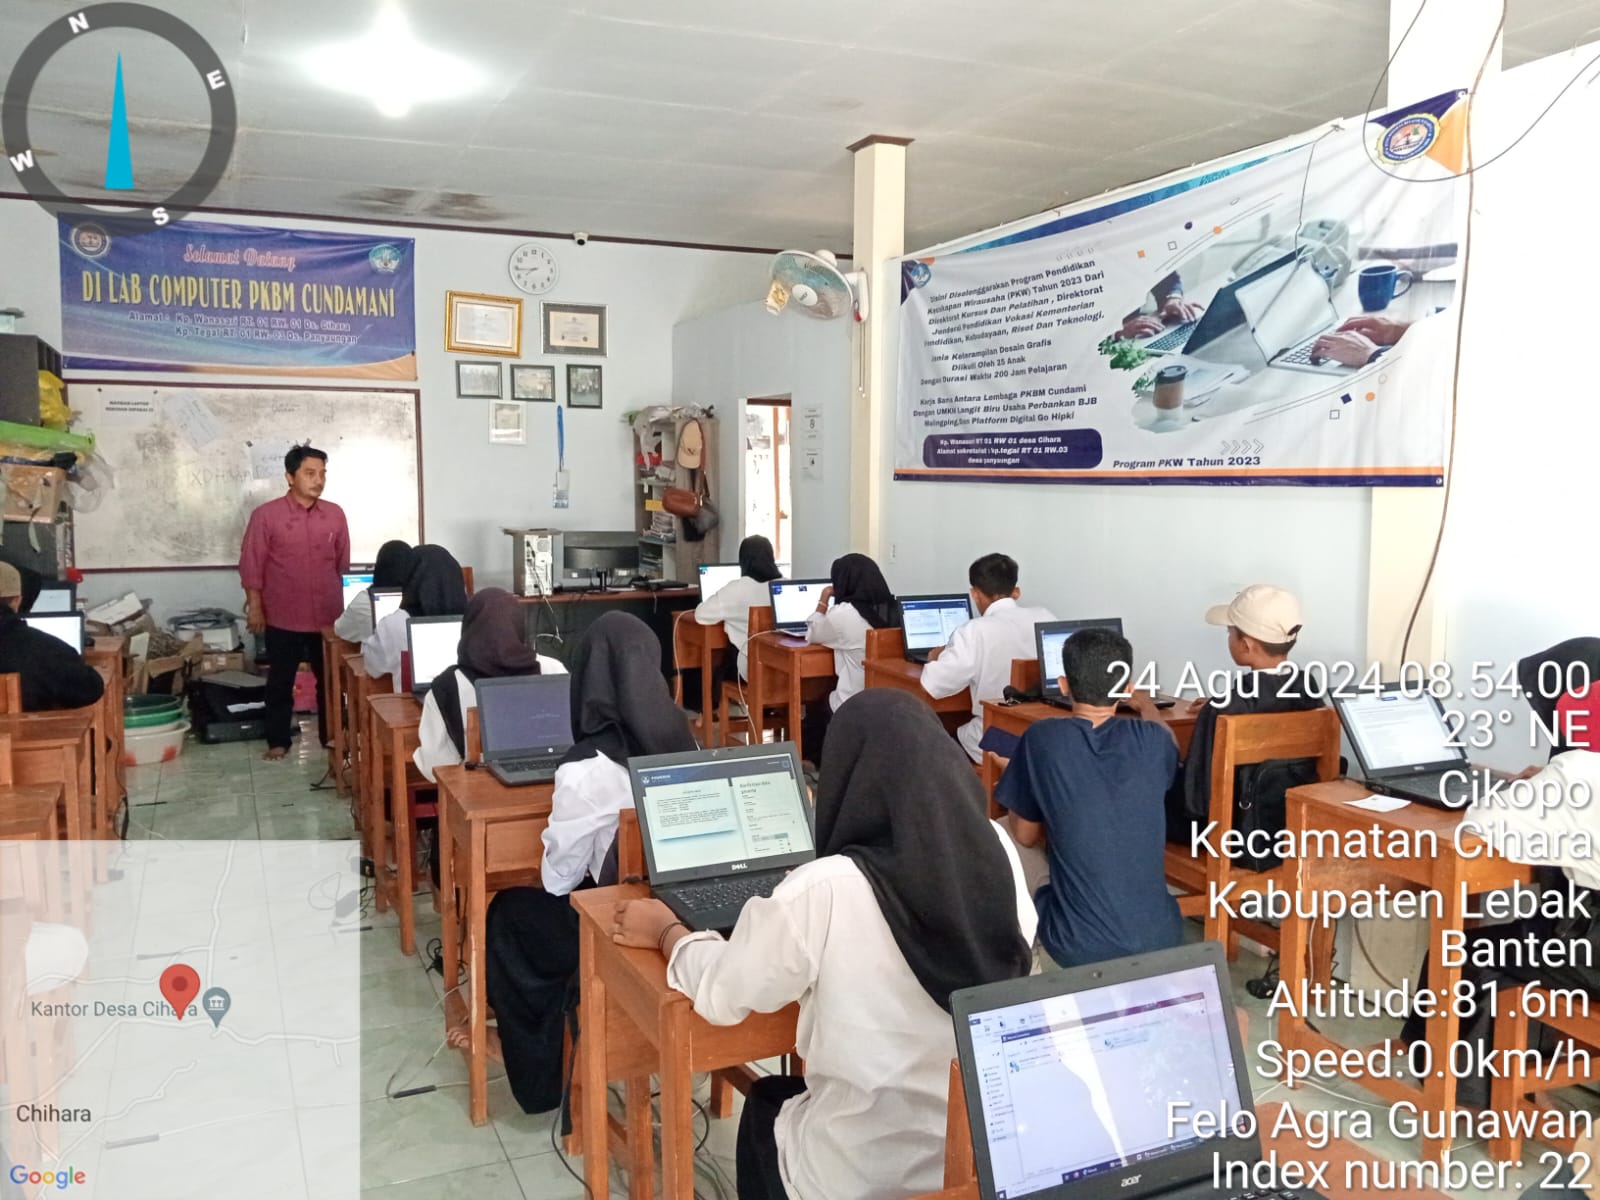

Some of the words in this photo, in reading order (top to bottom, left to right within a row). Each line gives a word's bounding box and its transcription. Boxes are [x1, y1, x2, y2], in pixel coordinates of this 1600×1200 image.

[1010, 273, 1044, 286] Program
[1045, 260, 1096, 278] Pendidikan
[82, 270, 102, 302] DI
[109, 272, 142, 304] LAB
[149, 274, 242, 310] COMPUTER
[249, 280, 296, 313] PKBM
[301, 284, 395, 318] CUNDAMANI
[964, 294, 1006, 308] Wirausaha
[1007, 288, 1032, 301] (PKW)
[1032, 282, 1058, 294] Tahun
[1060, 276, 1082, 288] 2023
[1084, 270, 1105, 282] Dari
[961, 309, 988, 318] Kursus
[990, 304, 1007, 314] Dan
[1009, 297, 1049, 311] Pelatihan
[1056, 285, 1104, 302] Direktorat
[128, 311, 164, 321] Alamat
[1005, 312, 1034, 322] Vokasi
[1036, 300, 1095, 318] Kementerian
[1011, 324, 1034, 334] Riset
[1036, 320, 1054, 330] Dan
[1000, 342, 1025, 354] Desain
[1026, 338, 1052, 349] Grafis
[978, 359, 995, 368] Oleh
[1006, 355, 1026, 365] Anak
[994, 370, 1009, 378] 200
[1010, 368, 1027, 378] Jam
[1028, 362, 1068, 376] Pelajaran
[954, 394, 981, 403] Antara
[983, 392, 1018, 402] Lembaga
[1020, 388, 1046, 398] PKBM
[1048, 384, 1087, 396] Cundami
[983, 404, 1000, 412] Biru
[1002, 403, 1026, 412] Usaha
[1028, 399, 1076, 410] Perbankan
[1078, 397, 1098, 406] BJB
[972, 414, 1008, 424] Platform
[1010, 414, 1036, 424] Digital
[1038, 414, 1049, 422] Go
[1051, 411, 1076, 422] Hipki
[1038, 436, 1062, 444] Cihara
[1113, 458, 1156, 470] Program
[1158, 458, 1184, 467] PKW
[1187, 457, 1224, 467] Tahun
[1228, 456, 1261, 466] 2023
[1120, 1174, 1142, 1188] acer
